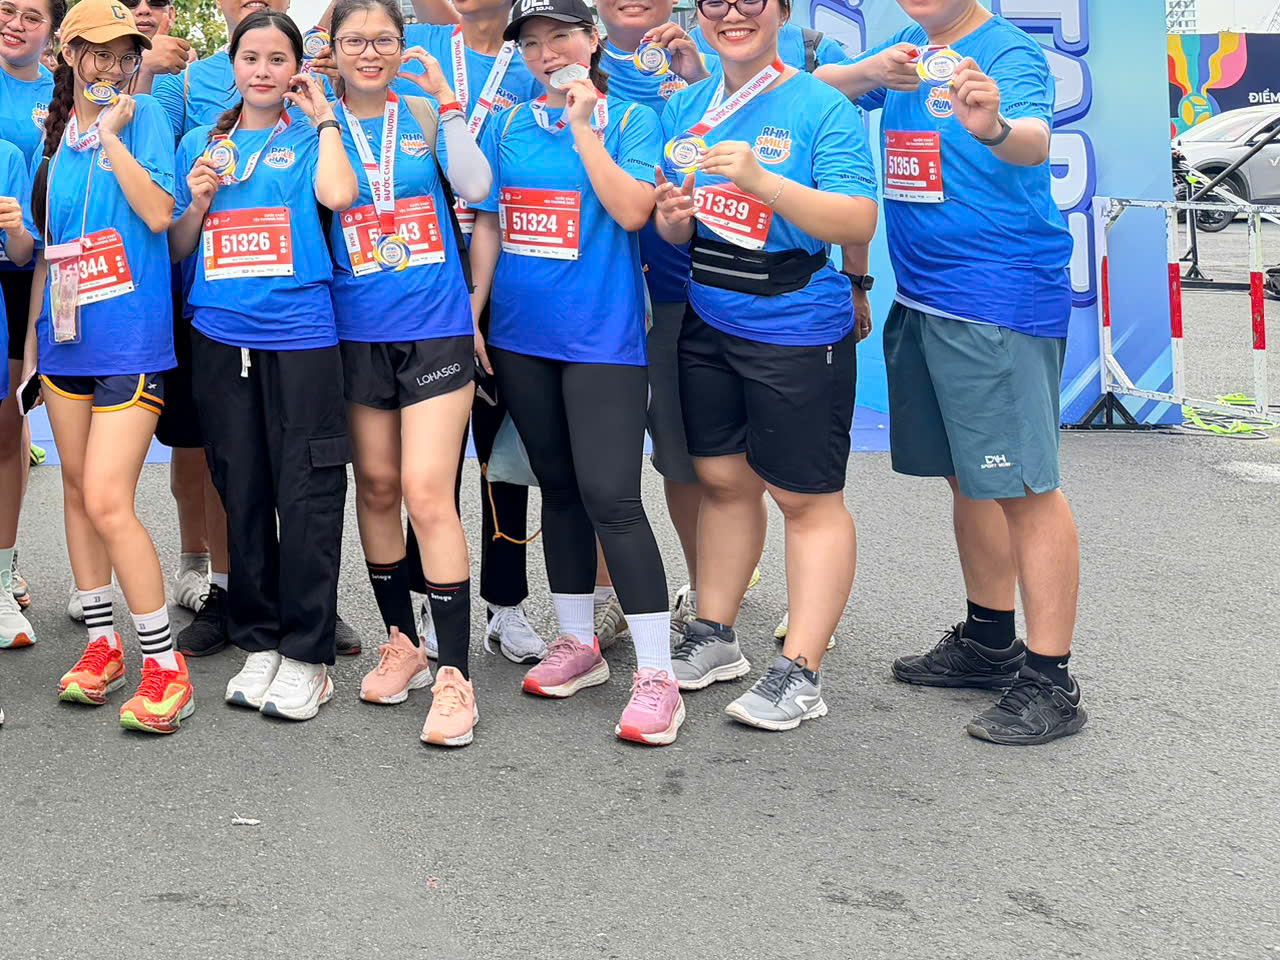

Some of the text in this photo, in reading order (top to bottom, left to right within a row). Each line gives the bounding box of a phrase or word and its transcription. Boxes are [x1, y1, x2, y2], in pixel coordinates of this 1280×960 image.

[756, 137, 791, 150] SMILE
[762, 127, 789, 139] RHM
[759, 146, 782, 158] RUN
[888, 155, 920, 176] 51356
[693, 189, 750, 221] 51339
[512, 212, 558, 233] 51324
[221, 232, 271, 254] 51326
[416, 362, 461, 387] LOHASGO
